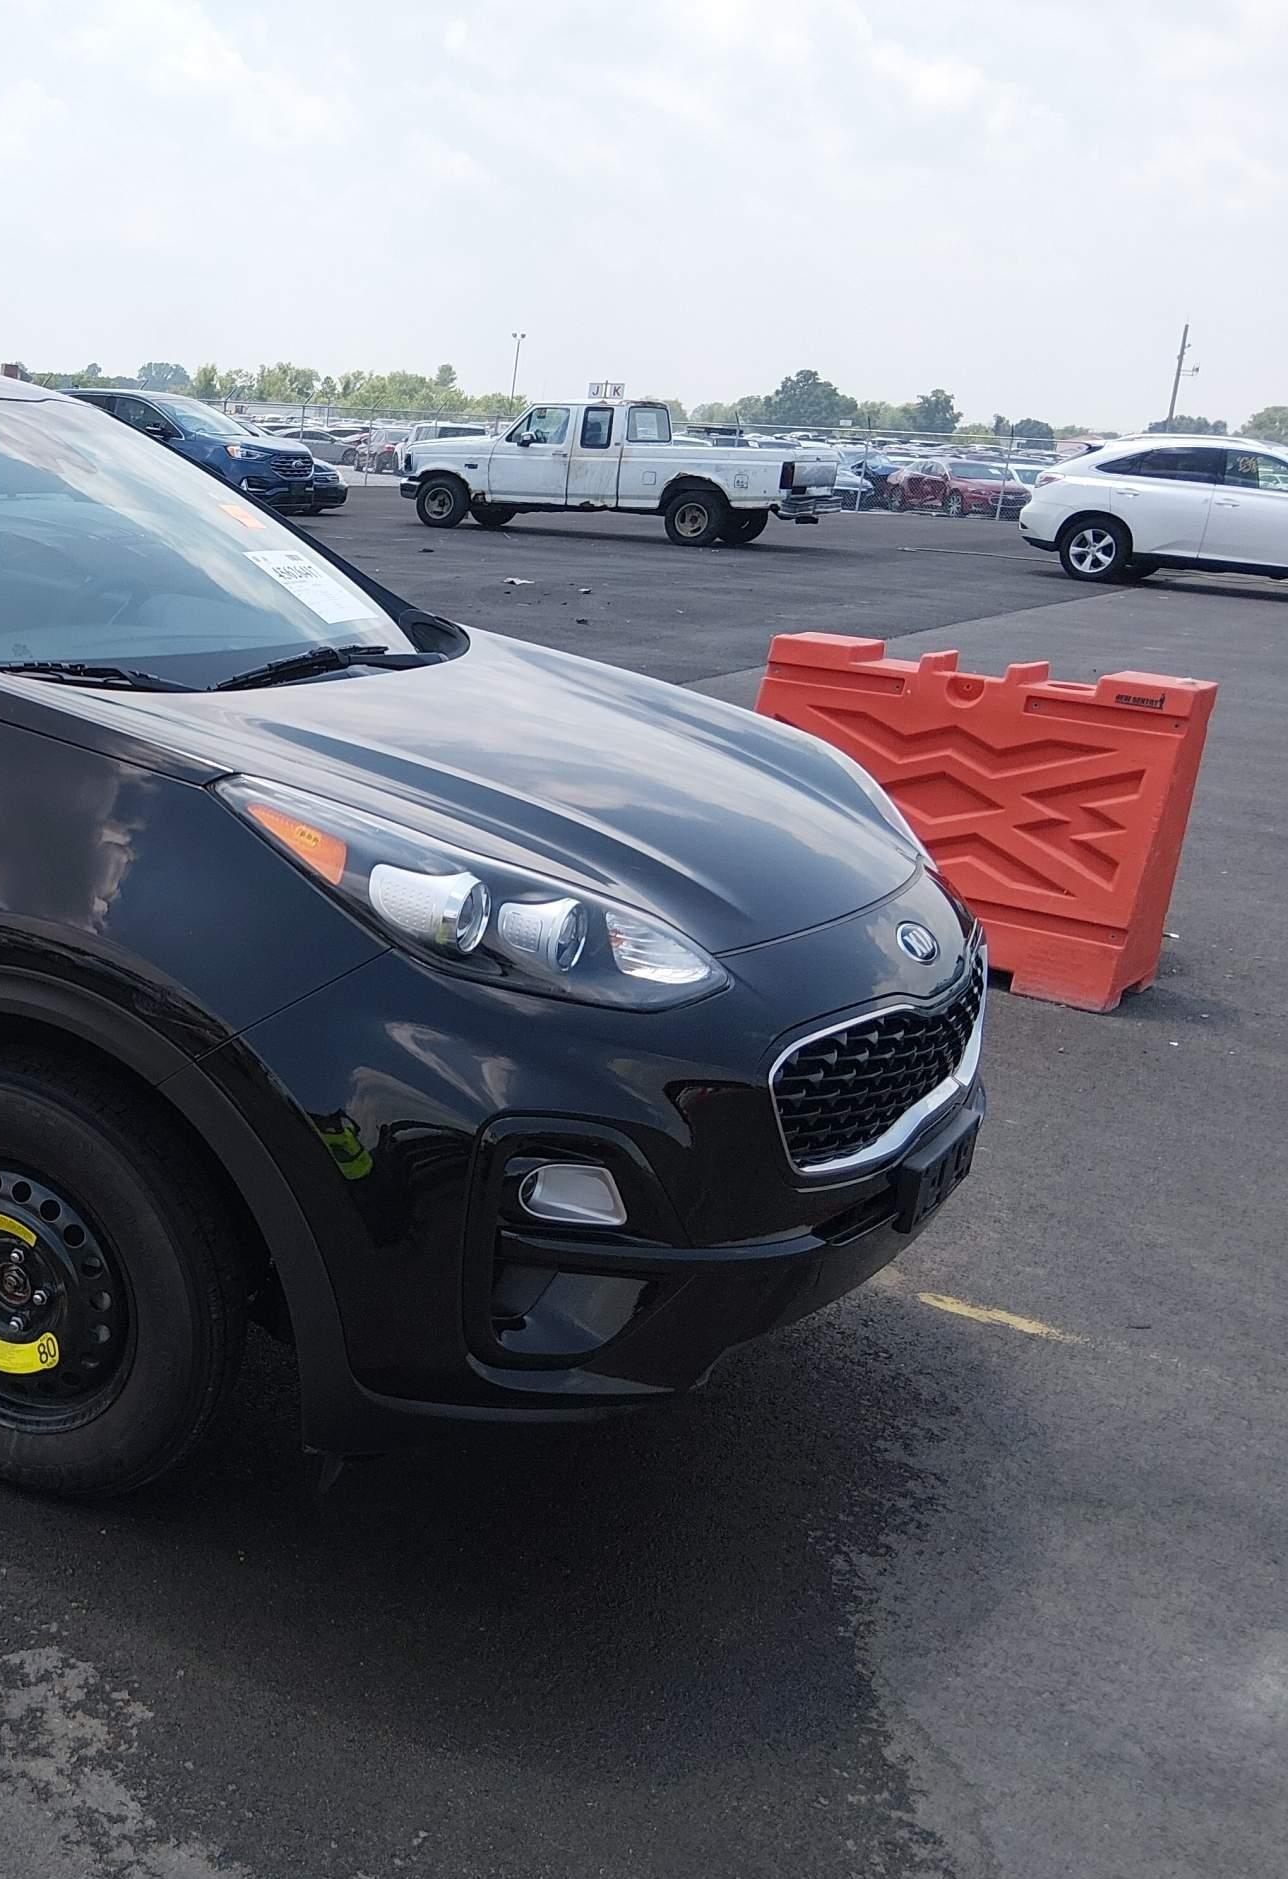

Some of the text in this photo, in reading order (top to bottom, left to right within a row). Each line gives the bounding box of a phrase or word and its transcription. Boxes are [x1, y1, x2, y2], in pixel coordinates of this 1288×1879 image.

[592, 385, 600, 396] J
[612, 385, 621, 397] K
[37, 1337, 56, 1364] 80
